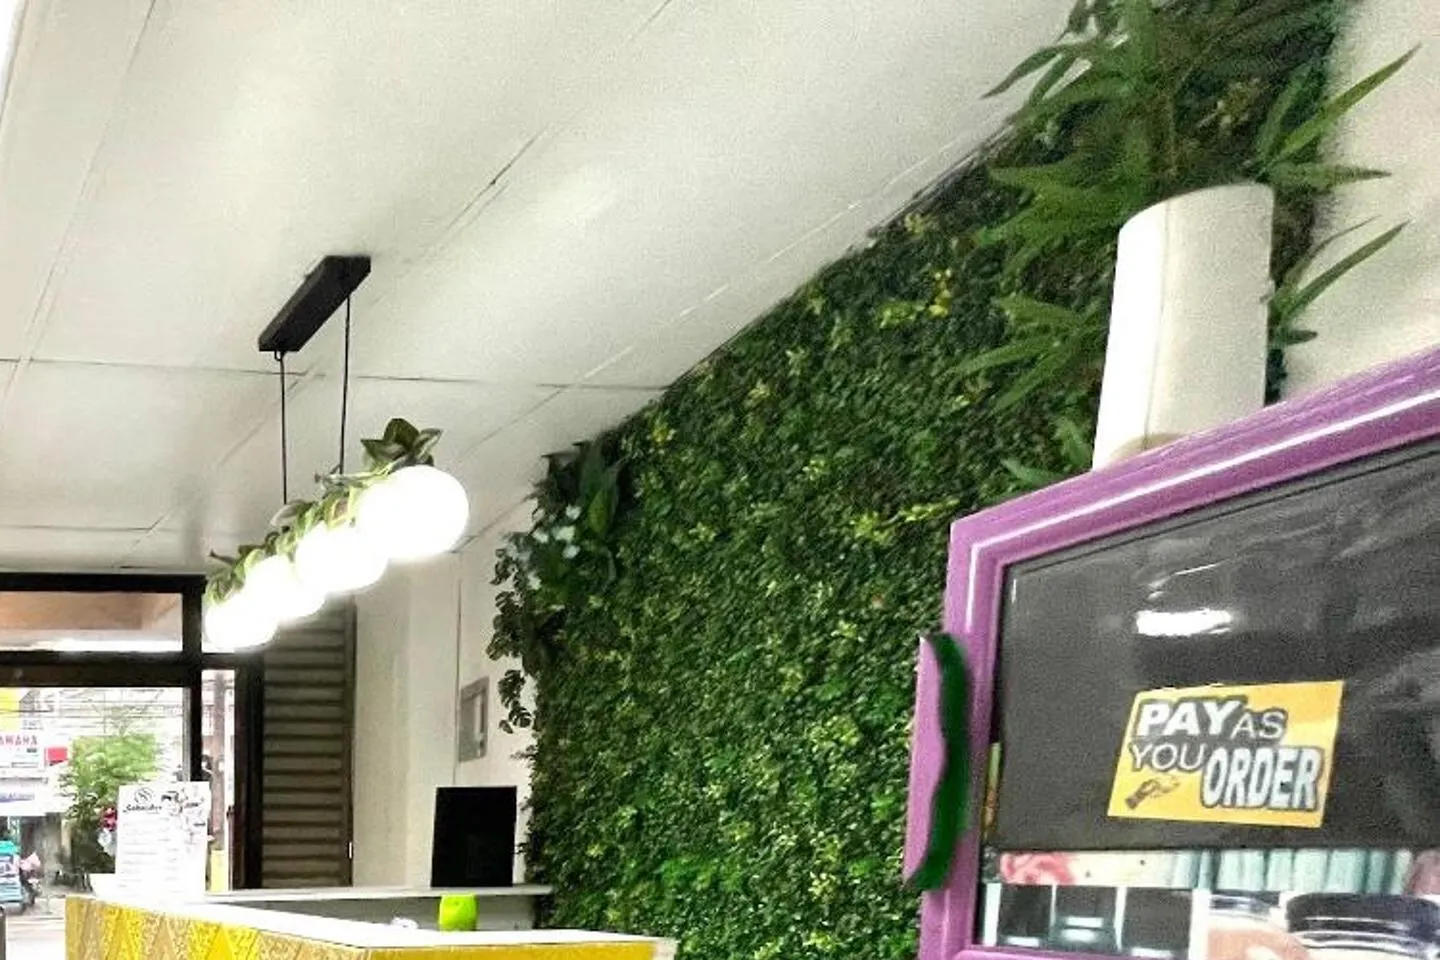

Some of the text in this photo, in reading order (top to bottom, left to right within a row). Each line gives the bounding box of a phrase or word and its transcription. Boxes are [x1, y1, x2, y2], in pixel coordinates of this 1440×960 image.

[1135, 698, 1286, 740] PAY AS
[1129, 741, 1323, 810] YOU ORDER
